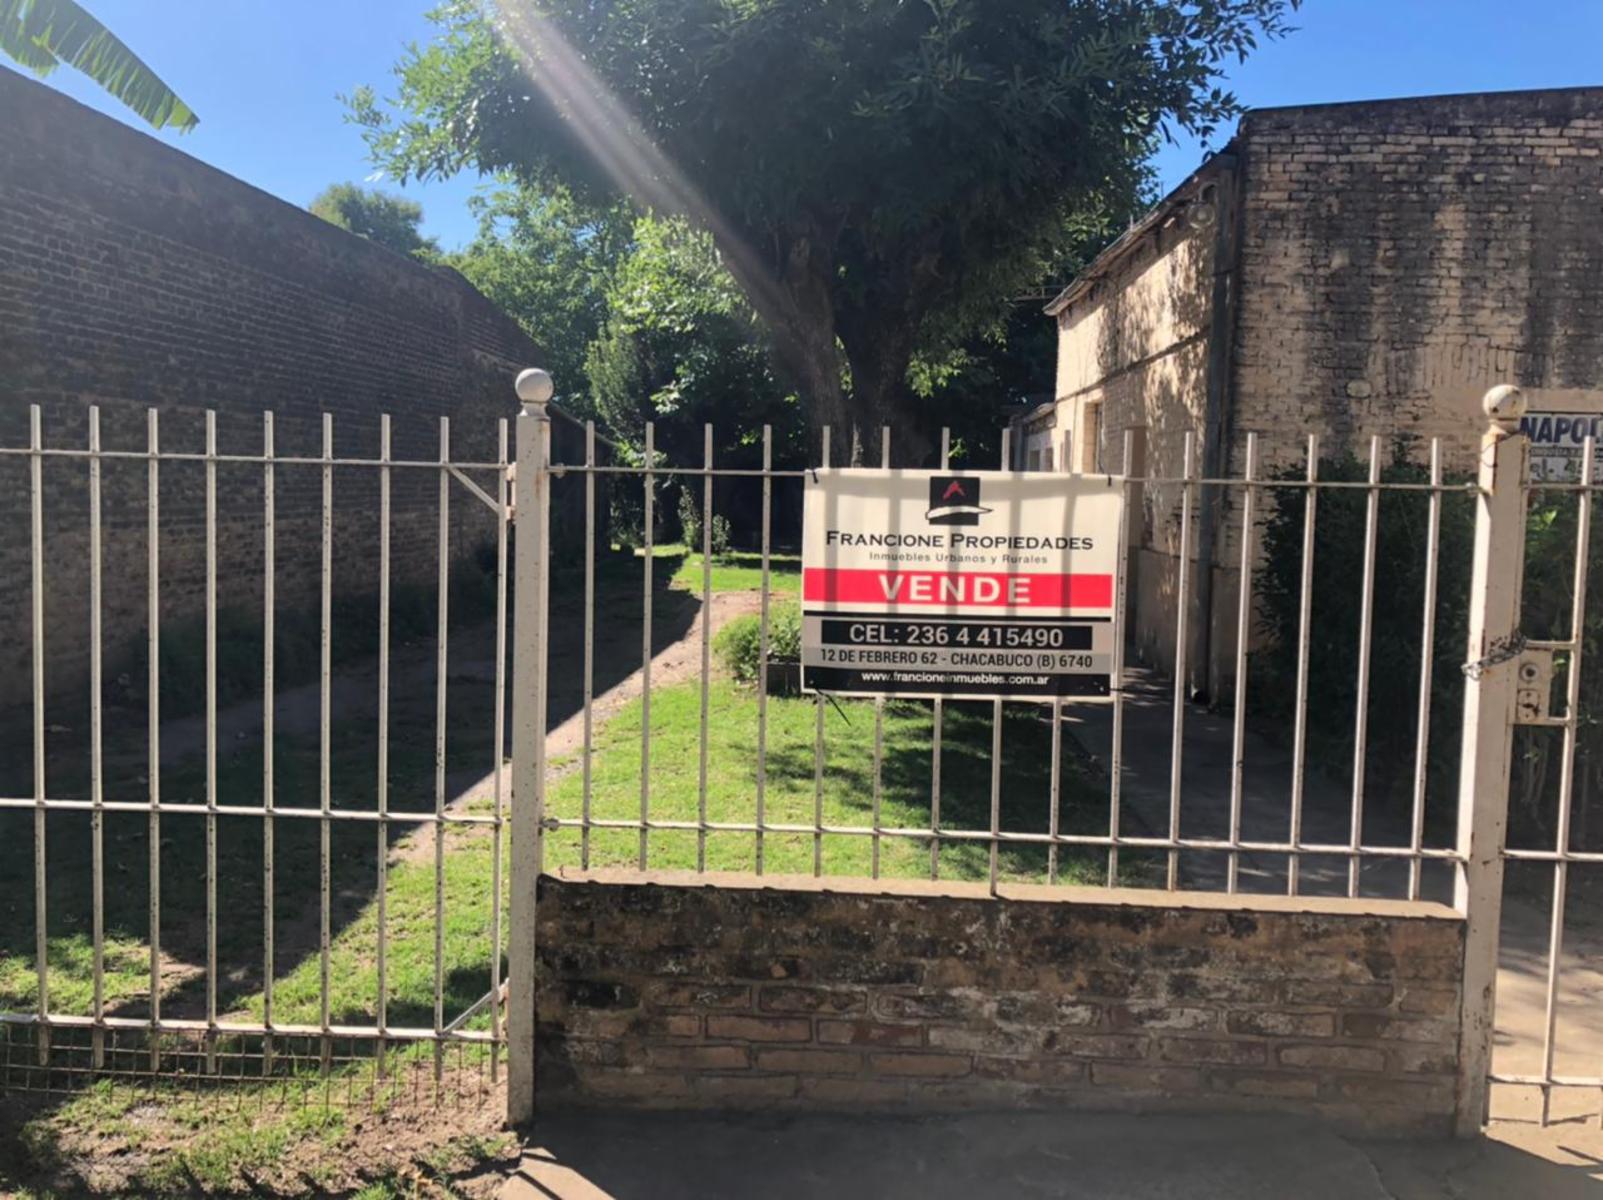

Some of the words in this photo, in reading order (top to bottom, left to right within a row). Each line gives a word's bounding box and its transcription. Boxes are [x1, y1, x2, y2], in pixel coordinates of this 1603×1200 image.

[826, 530, 944, 548] FRANCIONE
[950, 533, 1094, 550] PROPIEDADES
[869, 551, 931, 562] Inmuebles
[935, 552, 986, 563] Urbanos
[991, 555, 999, 565] y
[1002, 553, 1048, 564] Rurales
[878, 573, 1031, 604] VENDE
[849, 624, 899, 643] CEL:
[907, 625, 949, 645] 236
[955, 627, 970, 645] 4
[976, 627, 1064, 647] 415490
[821, 649, 836, 662] 12
[839, 650, 855, 663] DE
[859, 650, 918, 664] FEBRERO
[921, 652, 938, 665] 62
[951, 653, 1033, 667] CHACABUCO
[1037, 655, 1055, 669] (B)
[1059, 655, 1093, 668] 6740
[861, 672, 1049, 686] www.francioneinmuebles.com.ar
